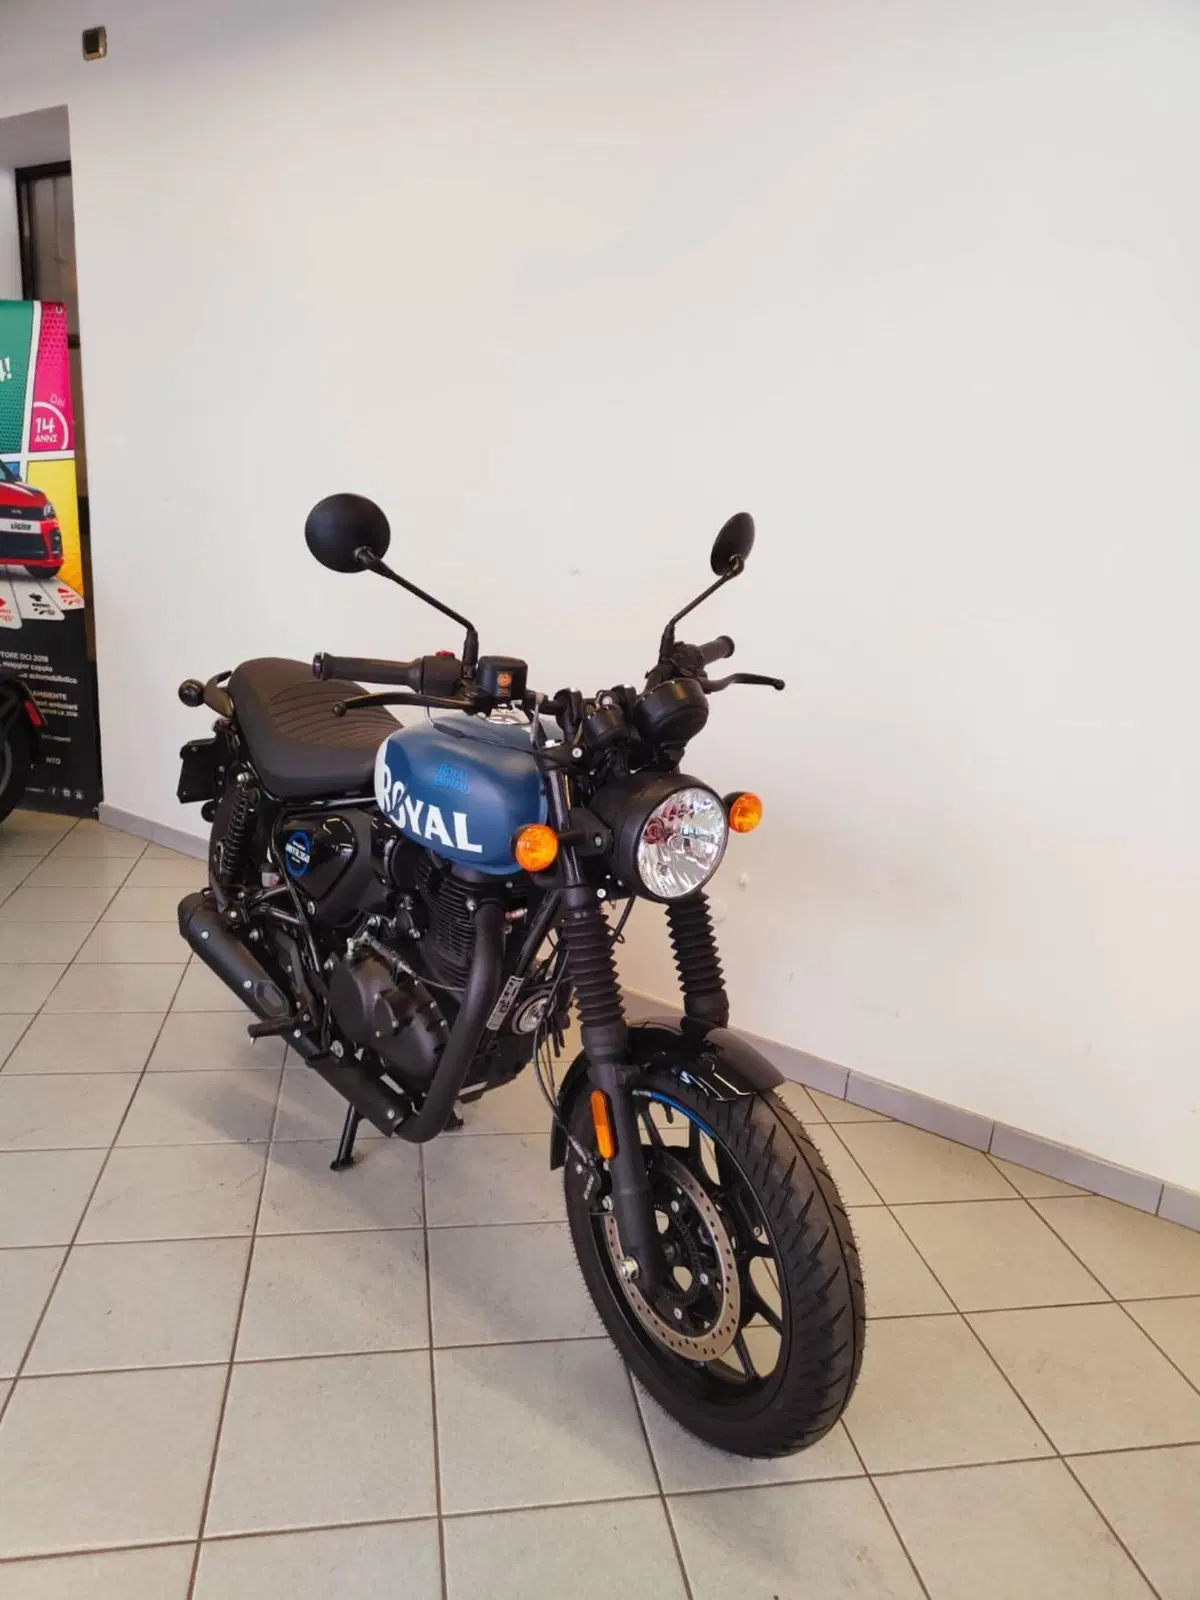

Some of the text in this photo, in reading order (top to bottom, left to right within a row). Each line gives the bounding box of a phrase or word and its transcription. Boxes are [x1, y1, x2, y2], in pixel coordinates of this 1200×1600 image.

[35, 417, 56, 434] 14
[31, 665, 53, 673] coppia
[375, 763, 483, 853] ROYAL
